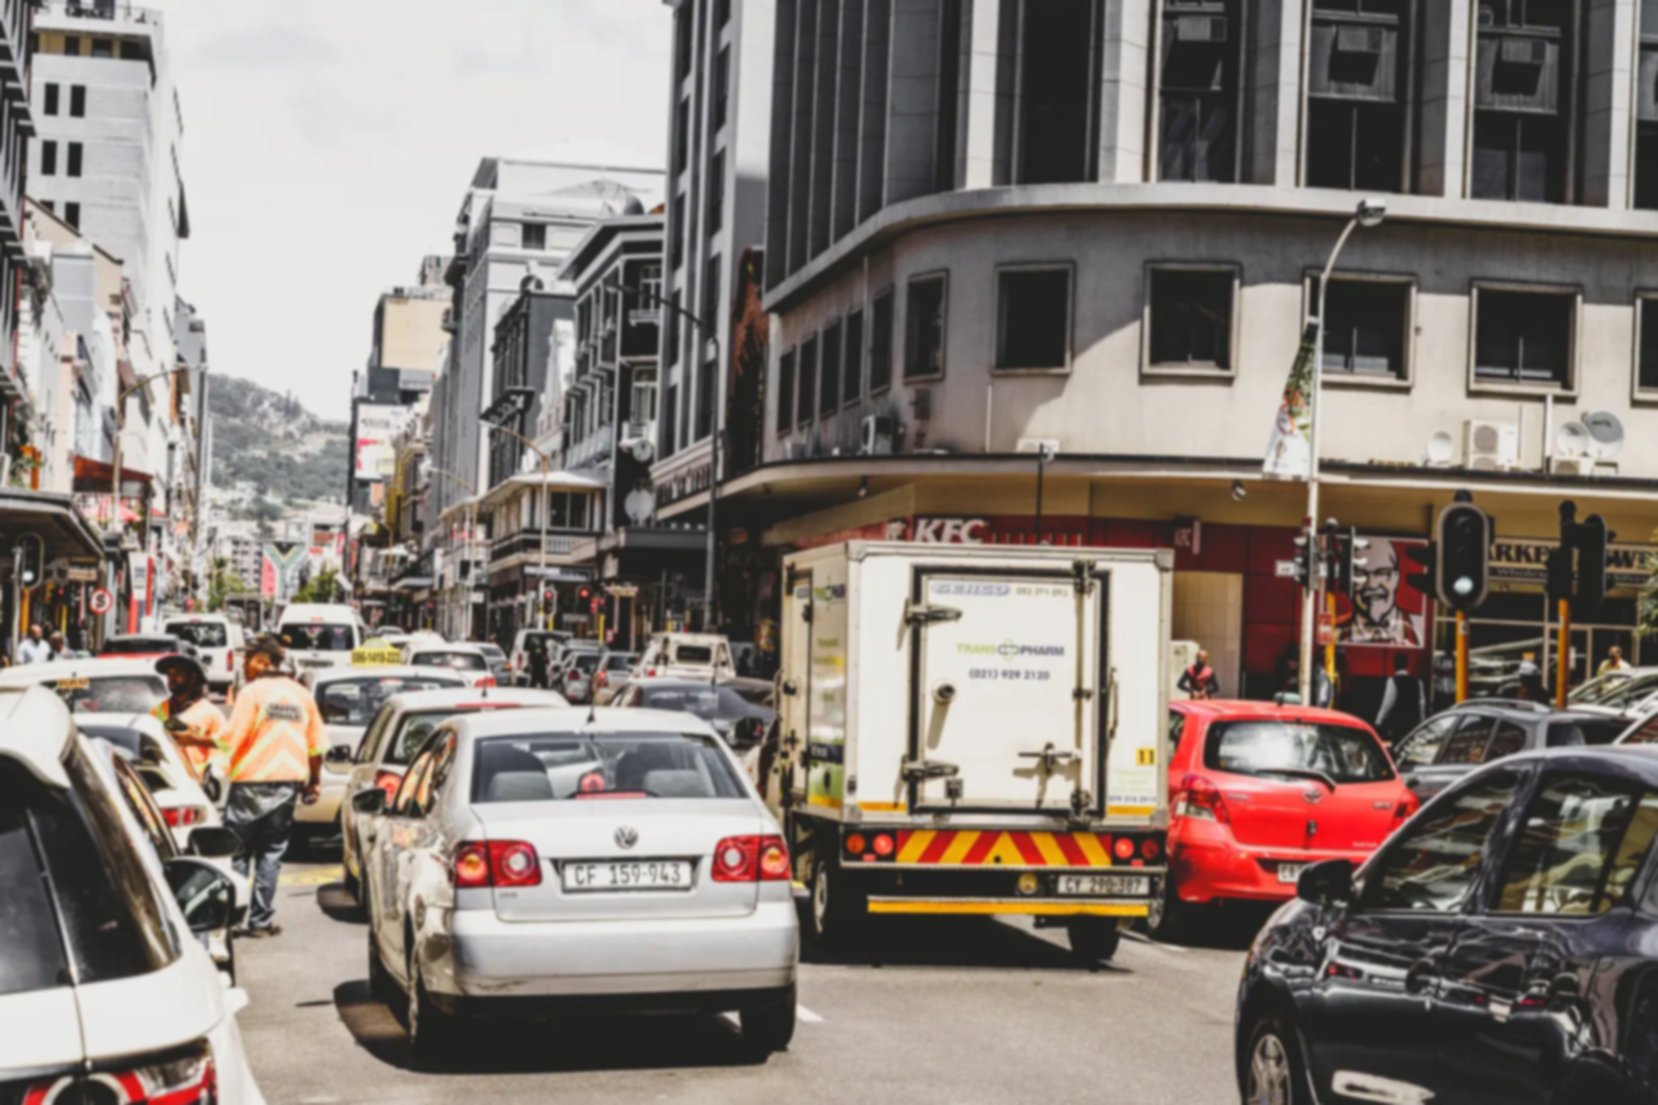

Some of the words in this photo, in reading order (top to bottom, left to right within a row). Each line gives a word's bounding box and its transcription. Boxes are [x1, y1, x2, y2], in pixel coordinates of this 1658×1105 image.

[915, 518, 985, 543] KFC
[1020, 645, 1065, 656] PHARM
[574, 865, 597, 885] CF
